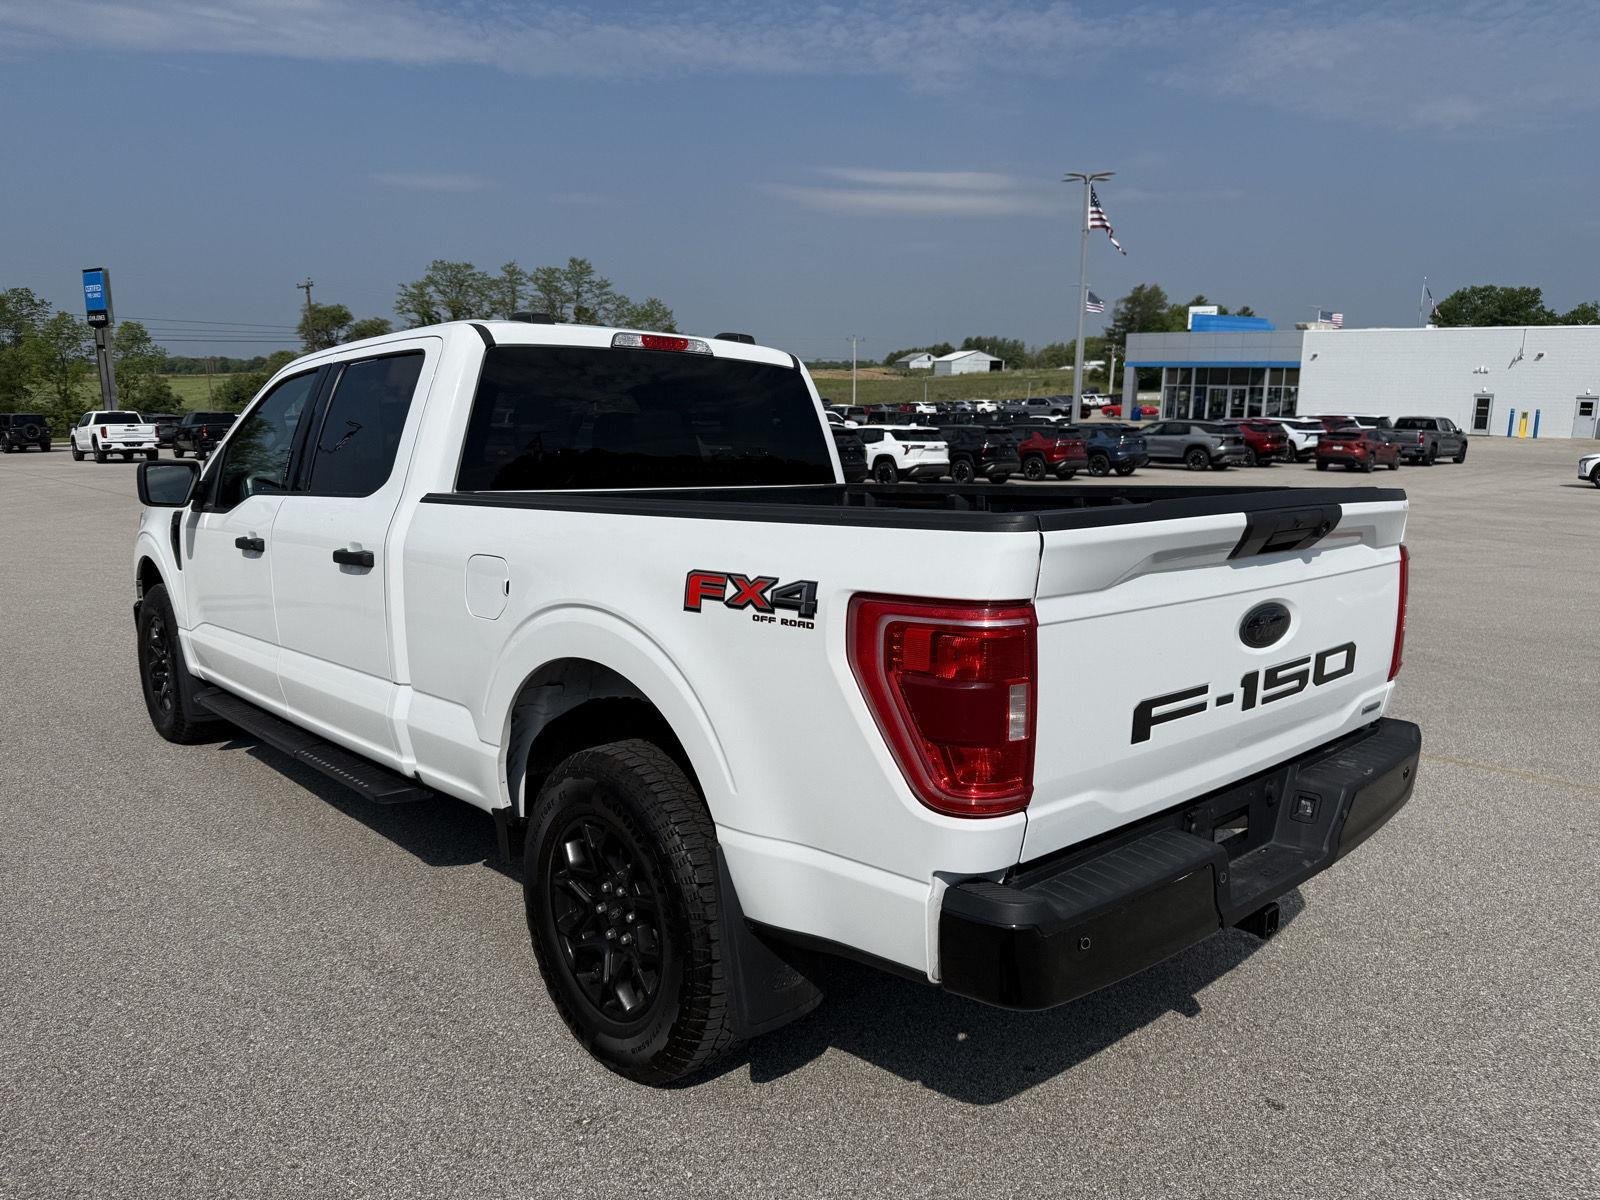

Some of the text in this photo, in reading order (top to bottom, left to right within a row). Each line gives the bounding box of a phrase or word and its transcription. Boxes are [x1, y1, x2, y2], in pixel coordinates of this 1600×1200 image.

[683, 568, 819, 621] FX4
[752, 614, 815, 630] OFF ROAD
[1130, 640, 1357, 745] F-150
